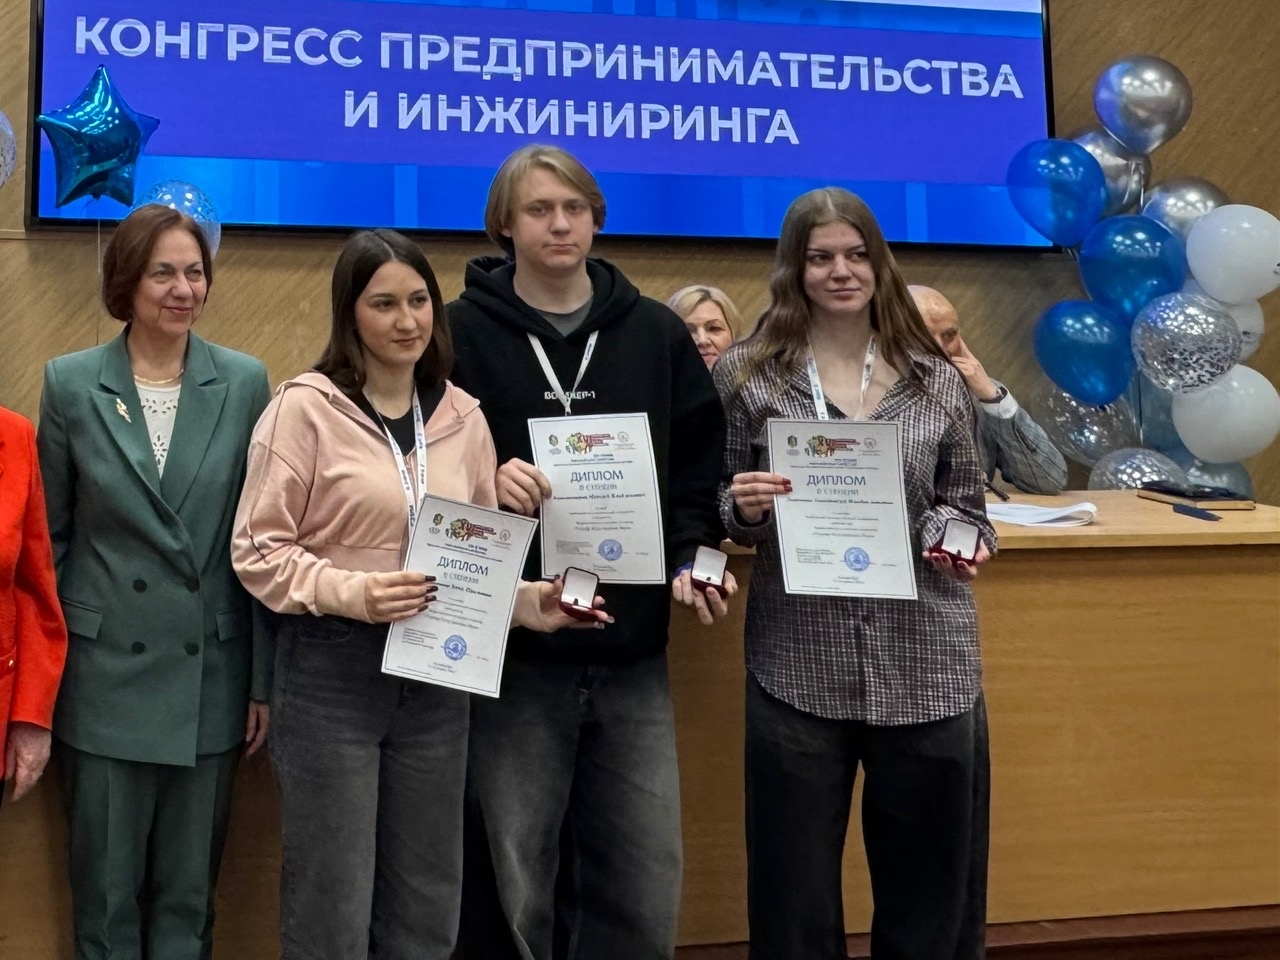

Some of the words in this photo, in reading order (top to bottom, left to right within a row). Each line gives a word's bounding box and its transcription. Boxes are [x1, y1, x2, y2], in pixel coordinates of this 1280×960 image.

[74, 16, 363, 67] КОНГРЕСС
[377, 30, 1023, 101] ПРЕДПРИНИМАТЕЛЬСТВА
[343, 91, 377, 129] И
[396, 93, 800, 147] ИНЖИНИРИНГА
[570, 471, 624, 483] ДИПЛОМ
[807, 475, 866, 486] ДИПЛОМ
[437, 556, 488, 576] ДИПЛОМ
